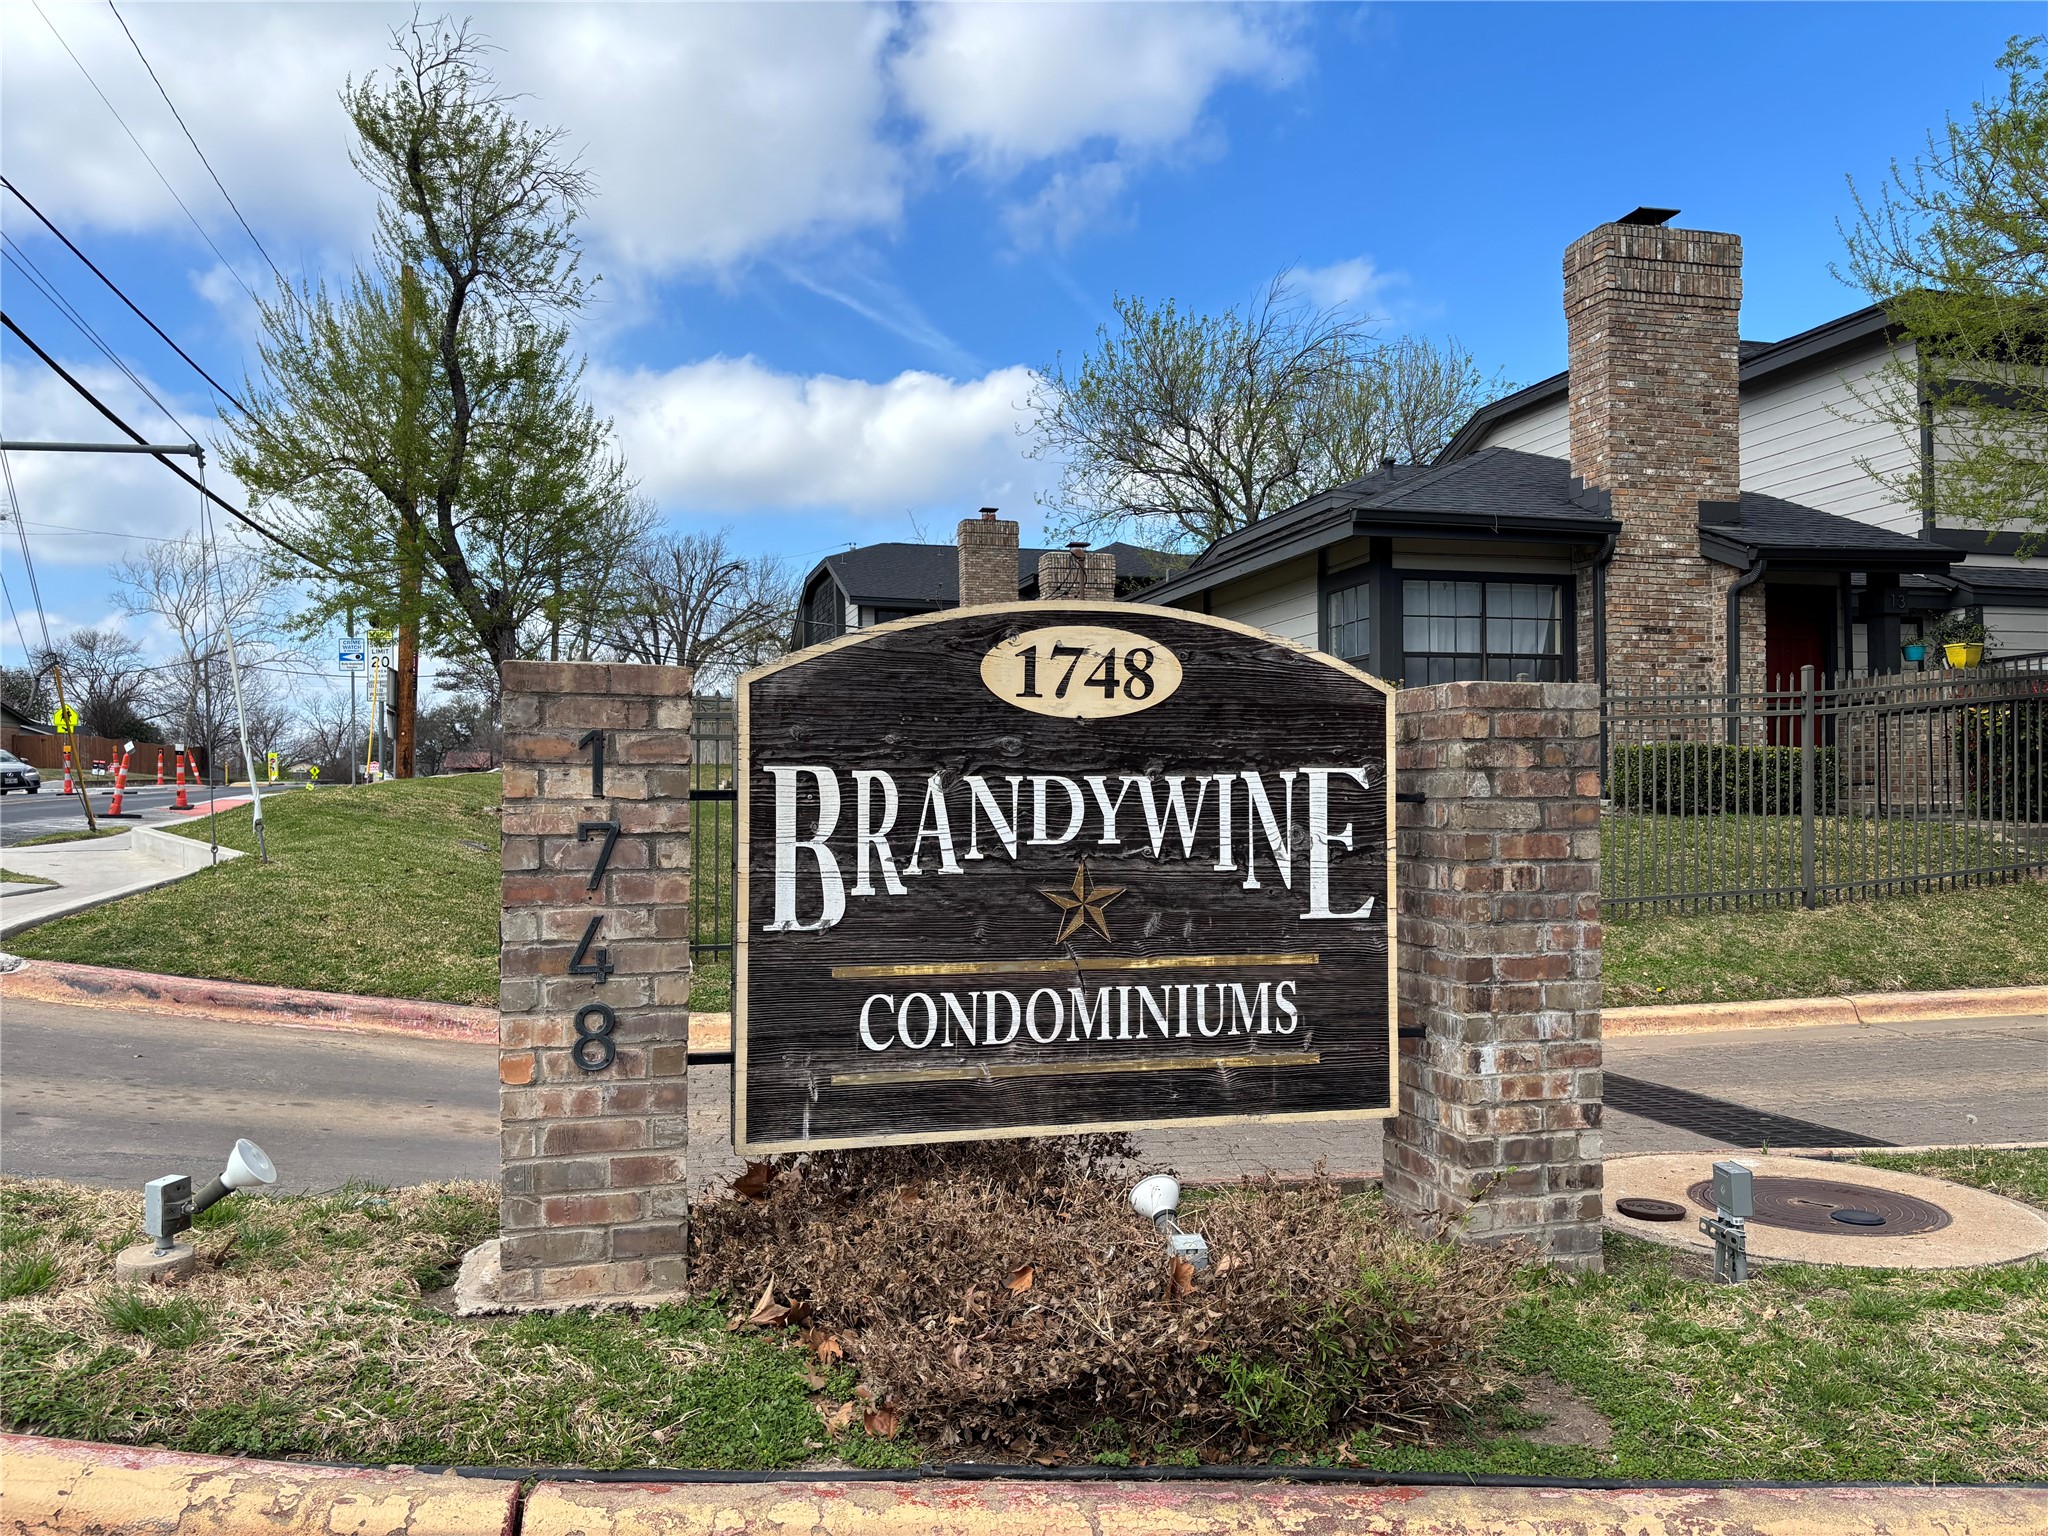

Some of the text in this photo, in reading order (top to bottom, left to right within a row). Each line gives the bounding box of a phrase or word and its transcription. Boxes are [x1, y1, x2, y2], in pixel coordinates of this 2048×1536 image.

[1891, 594, 1905, 608] 13
[371, 656, 390, 668] 20
[1015, 644, 1155, 699] 1748
[763, 766, 1374, 932] BRANDYWINE
[567, 729, 621, 1072] 1748
[860, 980, 1298, 1051] CONDOMINIUMS
